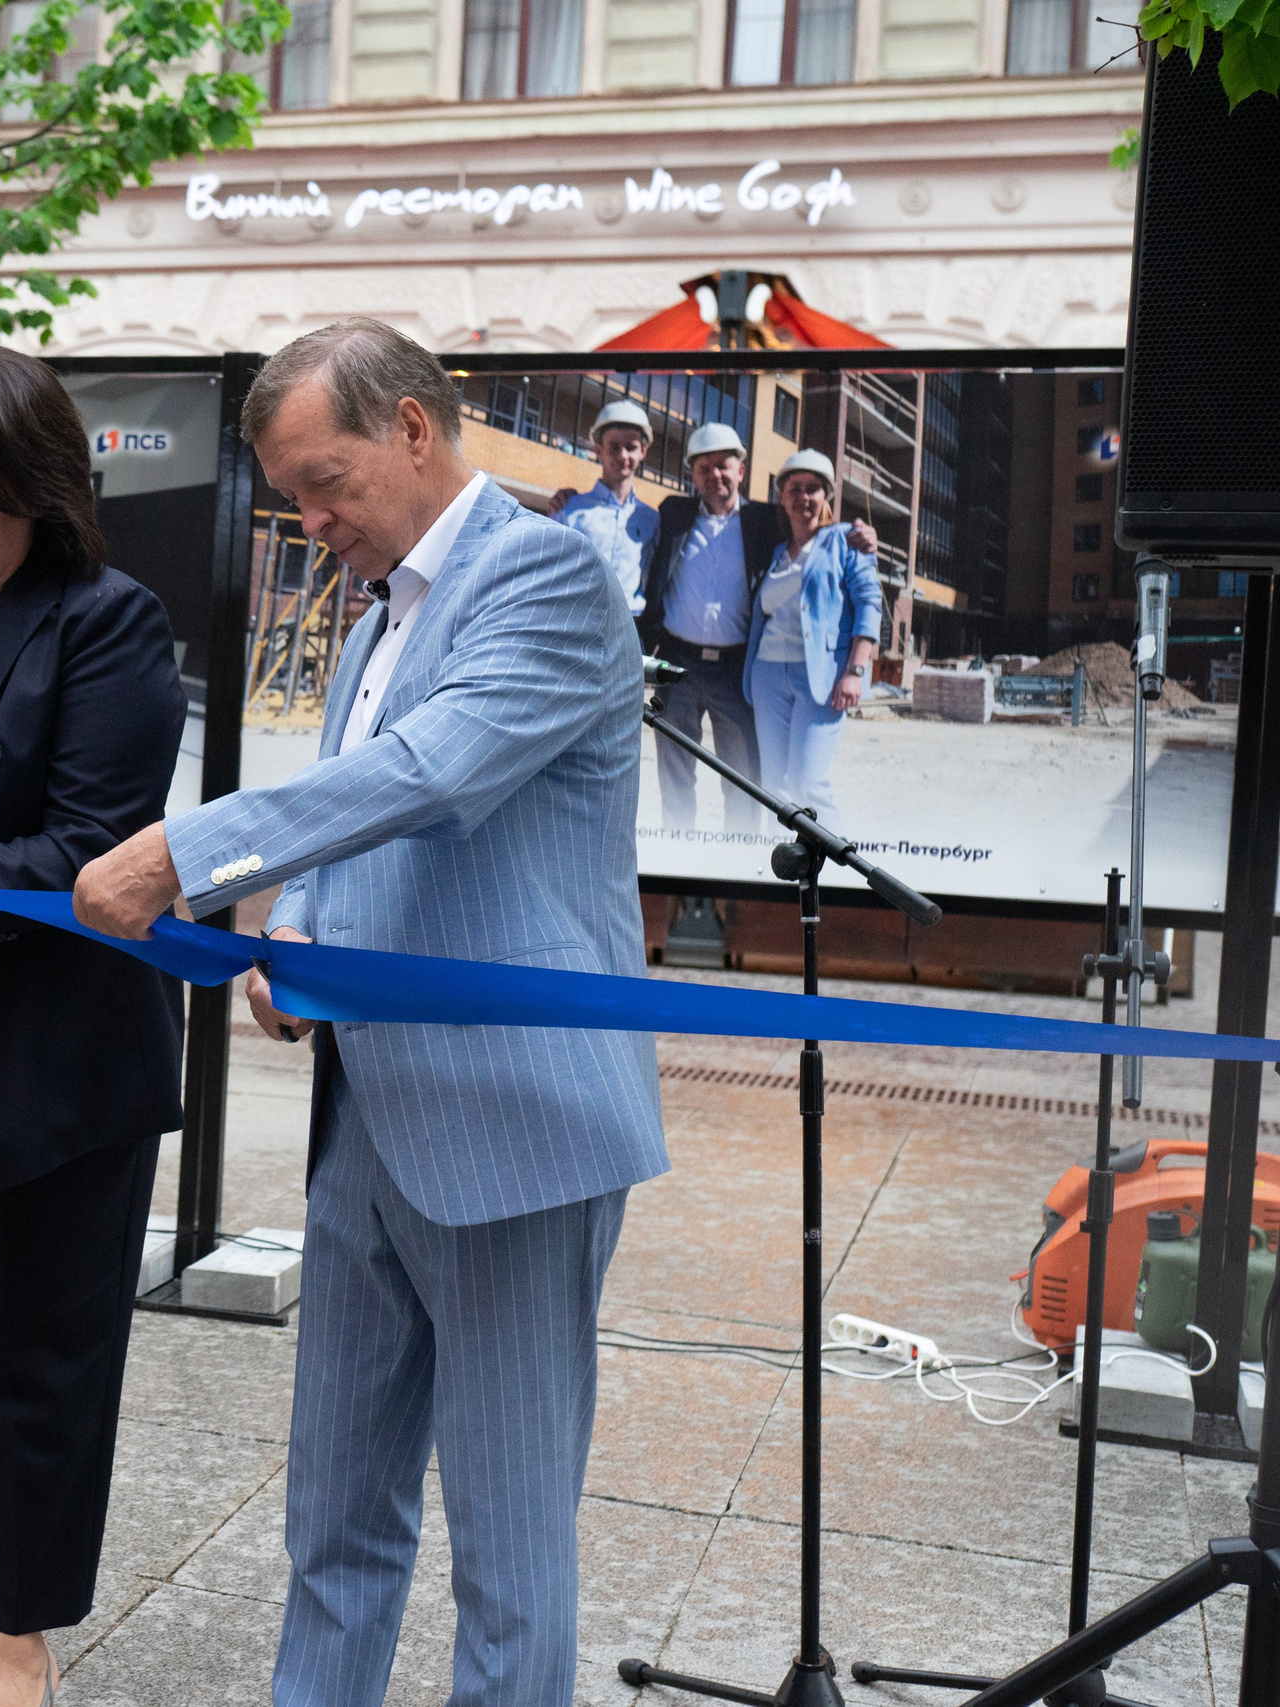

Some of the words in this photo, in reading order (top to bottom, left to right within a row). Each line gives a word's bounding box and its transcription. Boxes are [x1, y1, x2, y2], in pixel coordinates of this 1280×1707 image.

[344, 184, 584, 229] ресторан
[624, 166, 724, 214] Wine
[736, 159, 856, 227] Gogh
[125, 434, 166, 450] ПСБ
